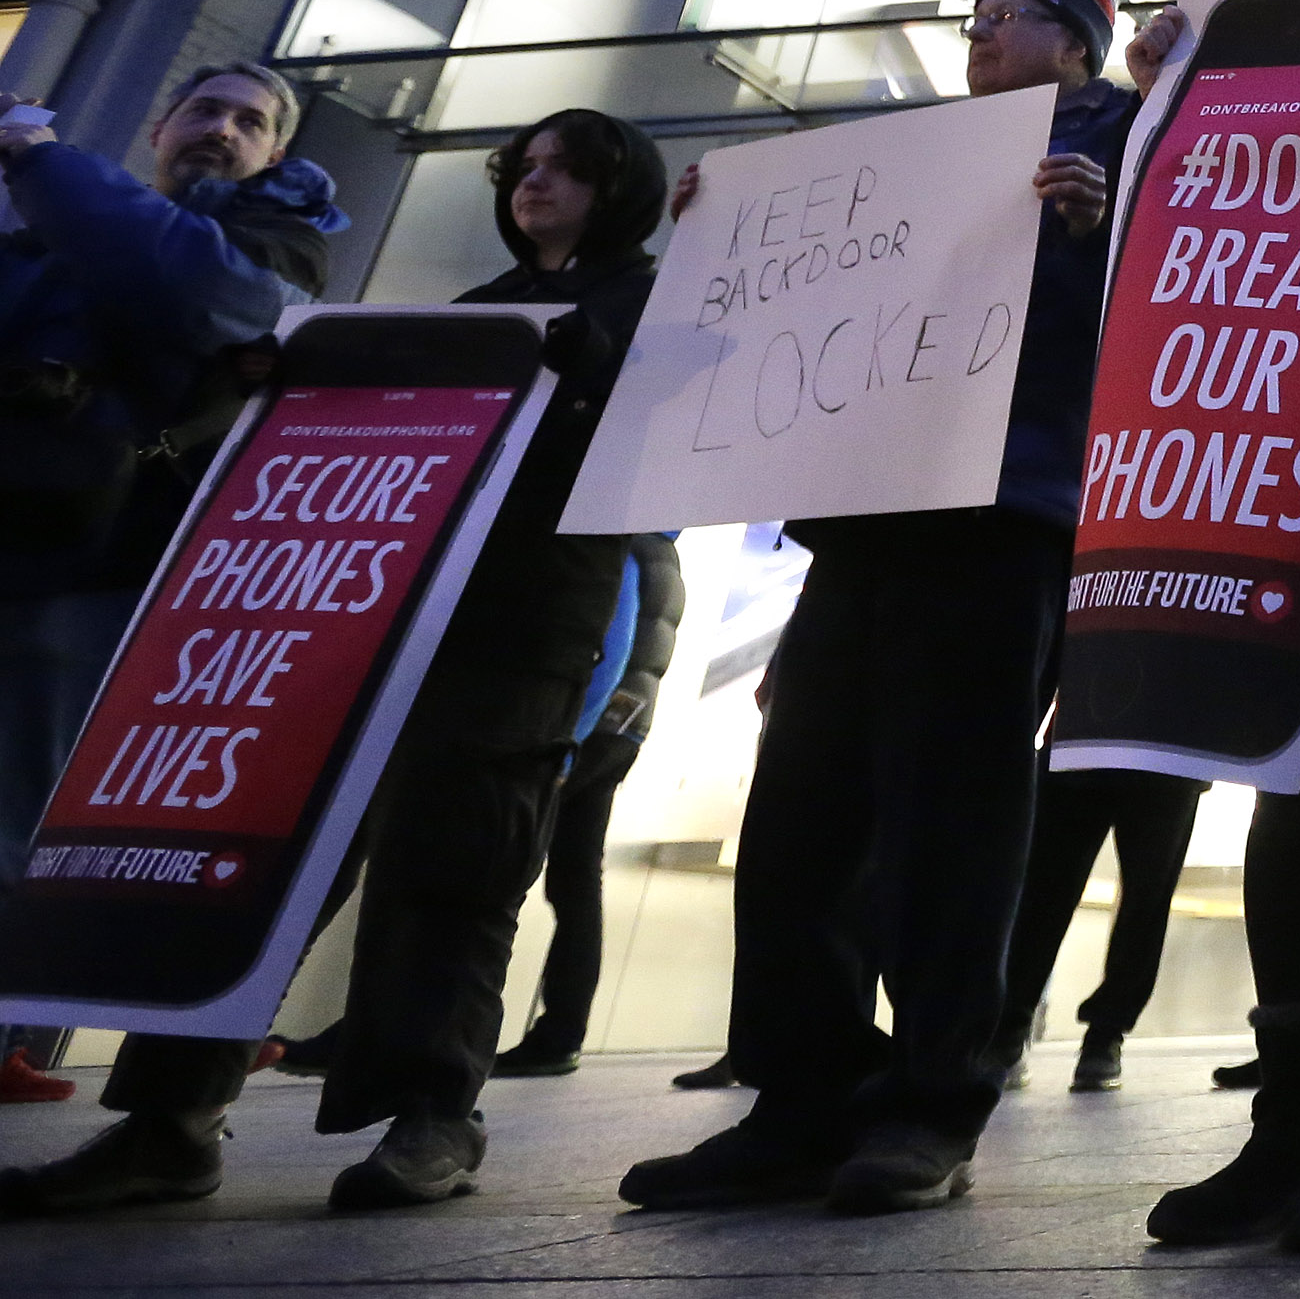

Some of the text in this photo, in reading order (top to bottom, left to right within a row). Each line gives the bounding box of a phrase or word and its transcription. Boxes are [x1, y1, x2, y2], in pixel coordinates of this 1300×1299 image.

[727, 166, 877, 260] KEEP
[696, 220, 911, 332] BACKDOOR
[692, 302, 1012, 453] LOCKED
[1149, 323, 1299, 414] OUR
[232, 455, 450, 523] SECURE
[171, 539, 403, 614] PHONES
[1144, 571, 1254, 616] FUTURE
[153, 628, 311, 707] SAVE
[88, 726, 260, 808] LIVES
[111, 847, 212, 883] FUTURE
